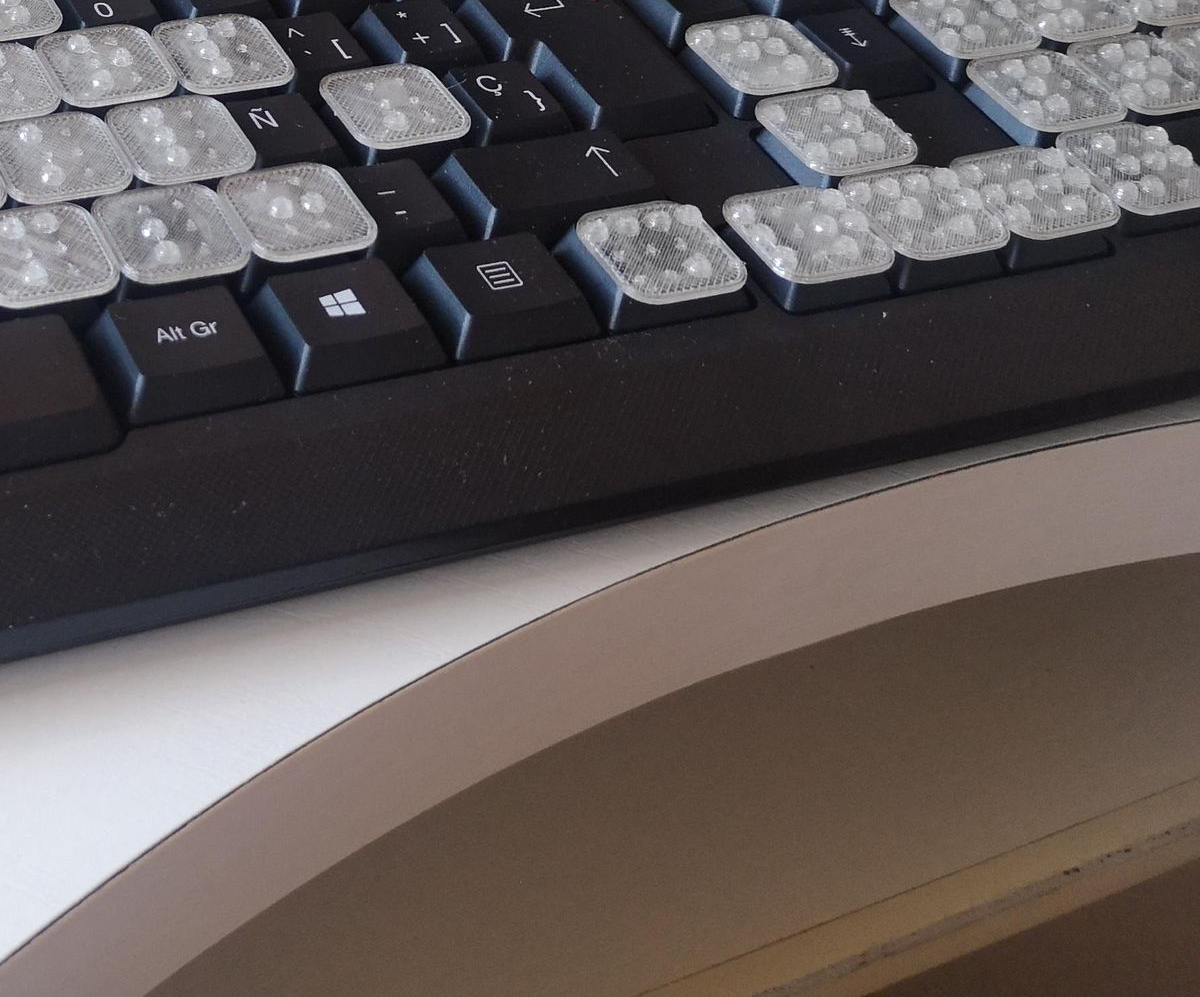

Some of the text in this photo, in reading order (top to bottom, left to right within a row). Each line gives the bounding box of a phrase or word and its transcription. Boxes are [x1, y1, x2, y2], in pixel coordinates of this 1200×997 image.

[248, 107, 279, 130] Ñ
[156, 318, 218, 344] Alt Gr
